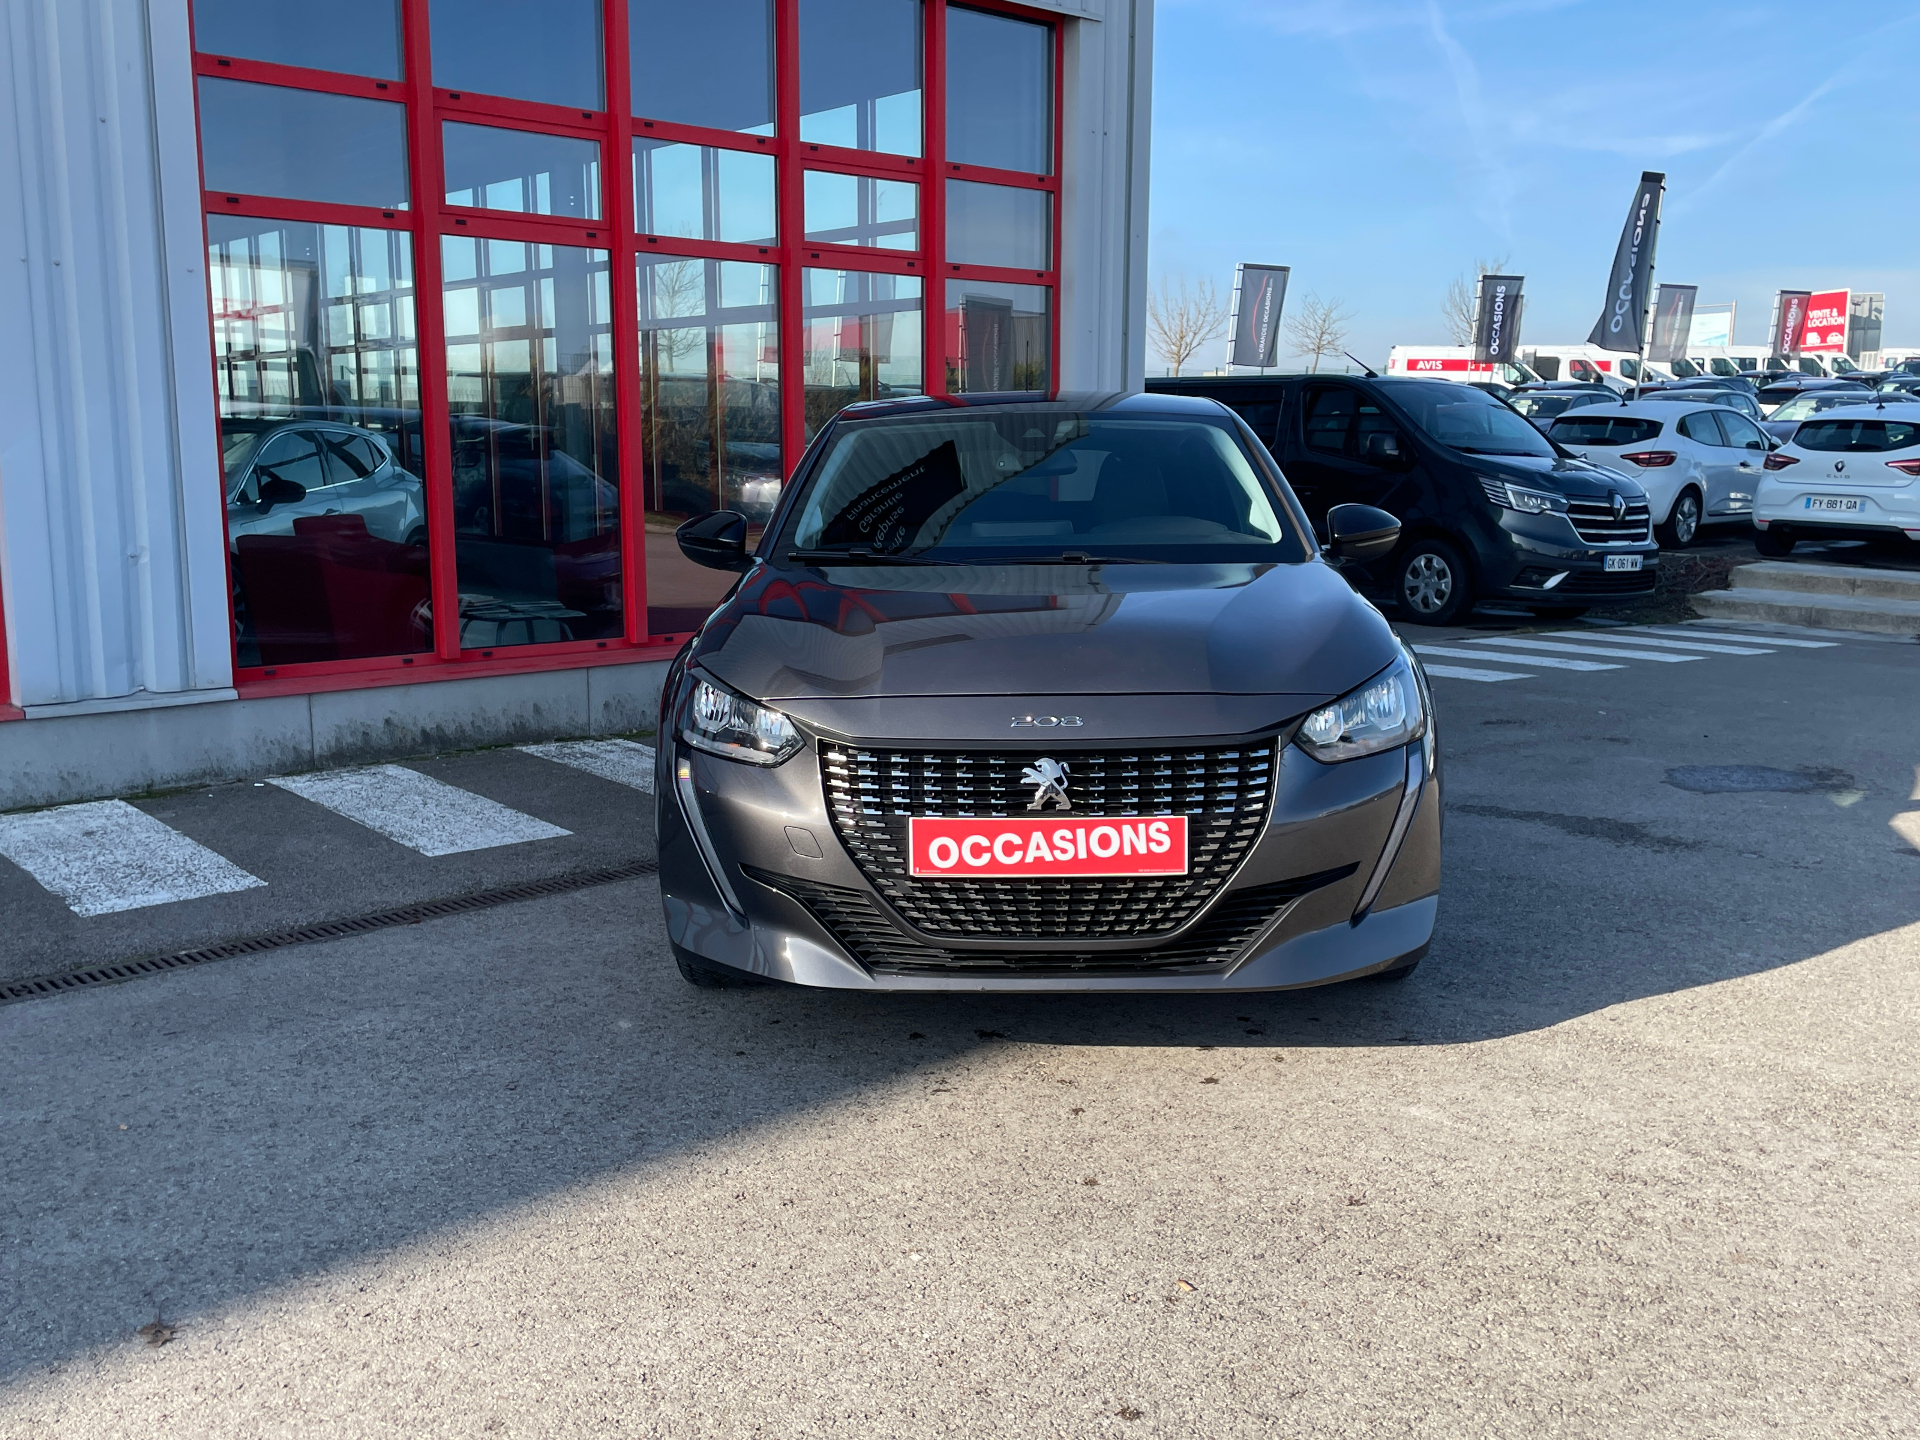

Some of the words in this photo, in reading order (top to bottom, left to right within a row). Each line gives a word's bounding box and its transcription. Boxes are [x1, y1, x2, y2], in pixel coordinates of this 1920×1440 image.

[1490, 285, 1506, 355] OCCASIONS
[1807, 316, 1845, 328] LOCATION
[1808, 308, 1831, 319] VENTE
[1782, 298, 1798, 354] OCCASIONS
[1259, 324, 1268, 353] GRANDES
[1416, 361, 1443, 370] AVIS
[1010, 714, 1085, 729] 208
[928, 821, 1172, 869] OCCASIONS
